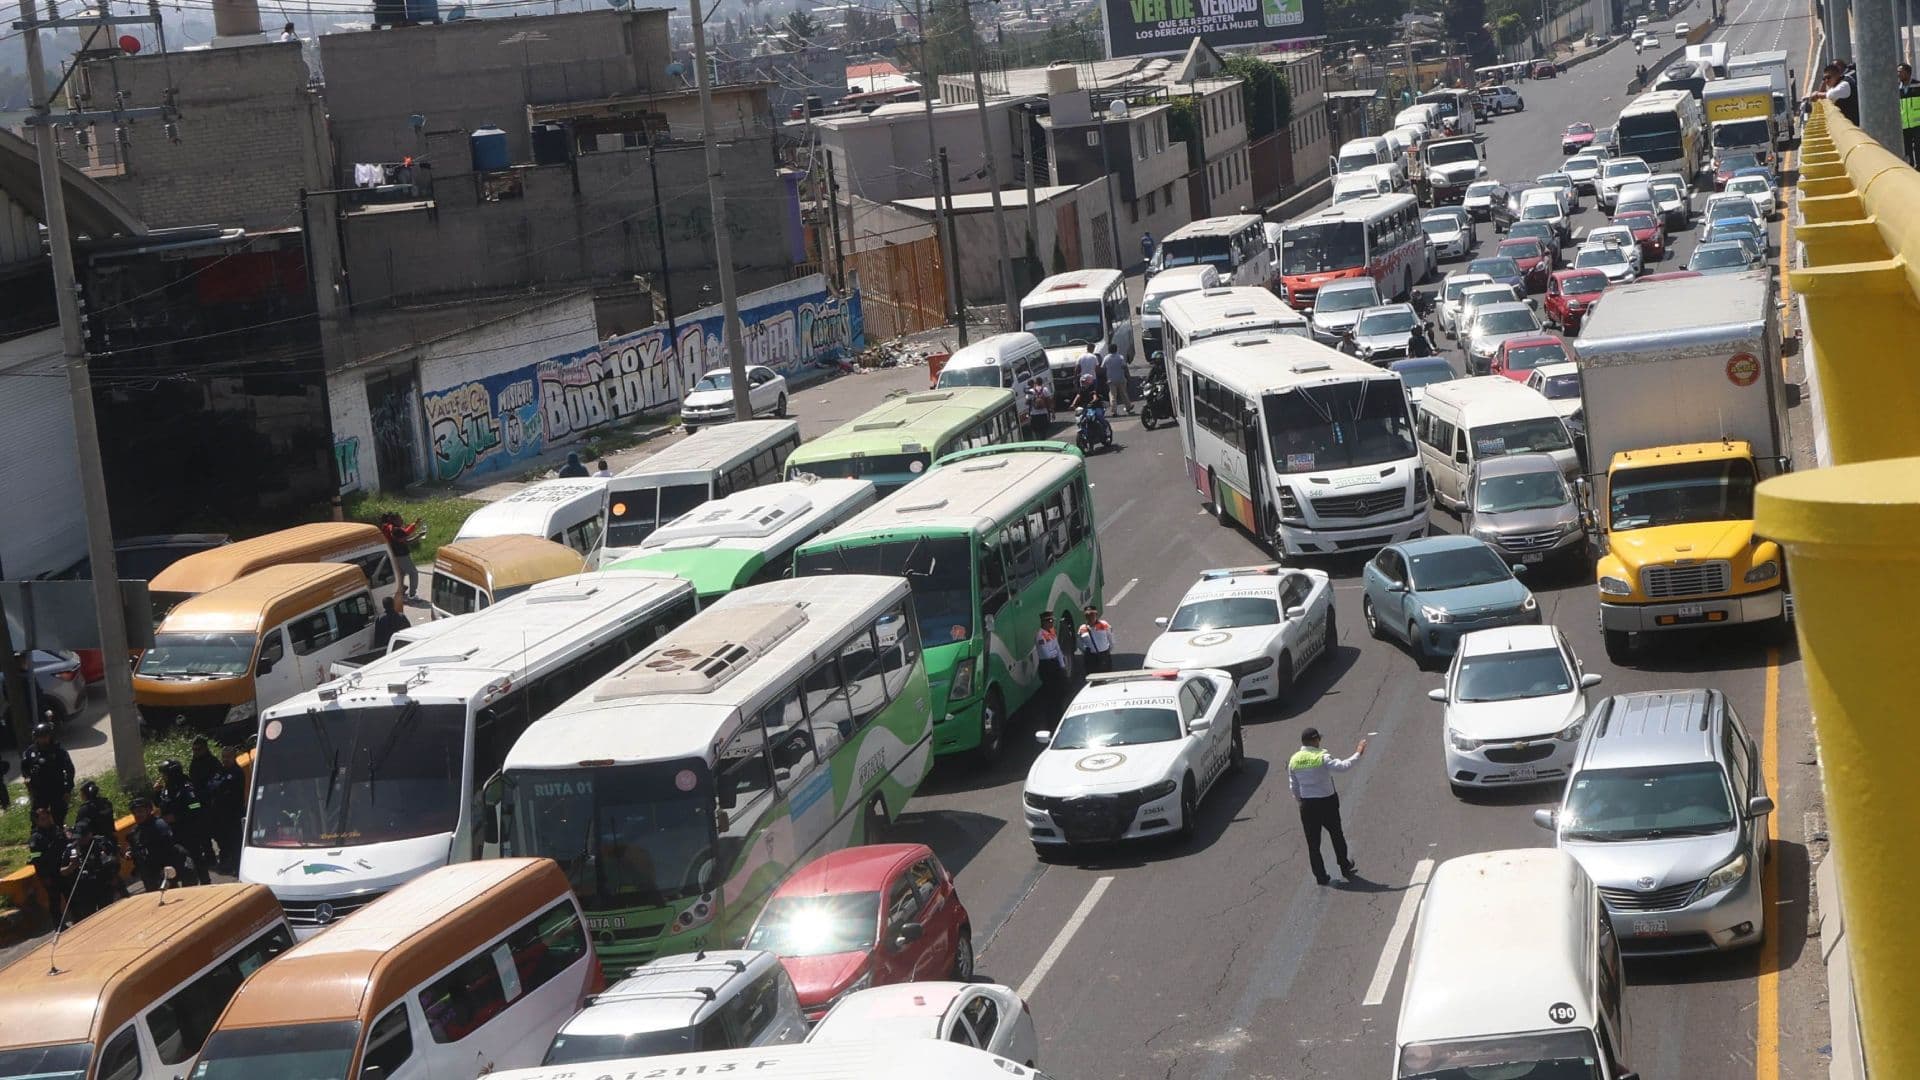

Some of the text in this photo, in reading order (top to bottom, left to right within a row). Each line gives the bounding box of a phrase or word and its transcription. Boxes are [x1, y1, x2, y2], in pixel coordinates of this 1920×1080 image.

[1130, 0, 1167, 23] VER
[1171, 0, 1195, 19] DE
[1266, 11, 1301, 25] VERDE
[1158, 14, 1234, 28] QUE SE RESPETEN
[1136, 20, 1258, 39] LOS DERECHOS DE LA MUJER
[586, 338, 660, 383] MOY
[534, 781, 592, 796] RUTA 01
[614, 917, 625, 928] 01
[1550, 1007, 1575, 1020] 190
[595, 1059, 781, 1080] A12113 F
